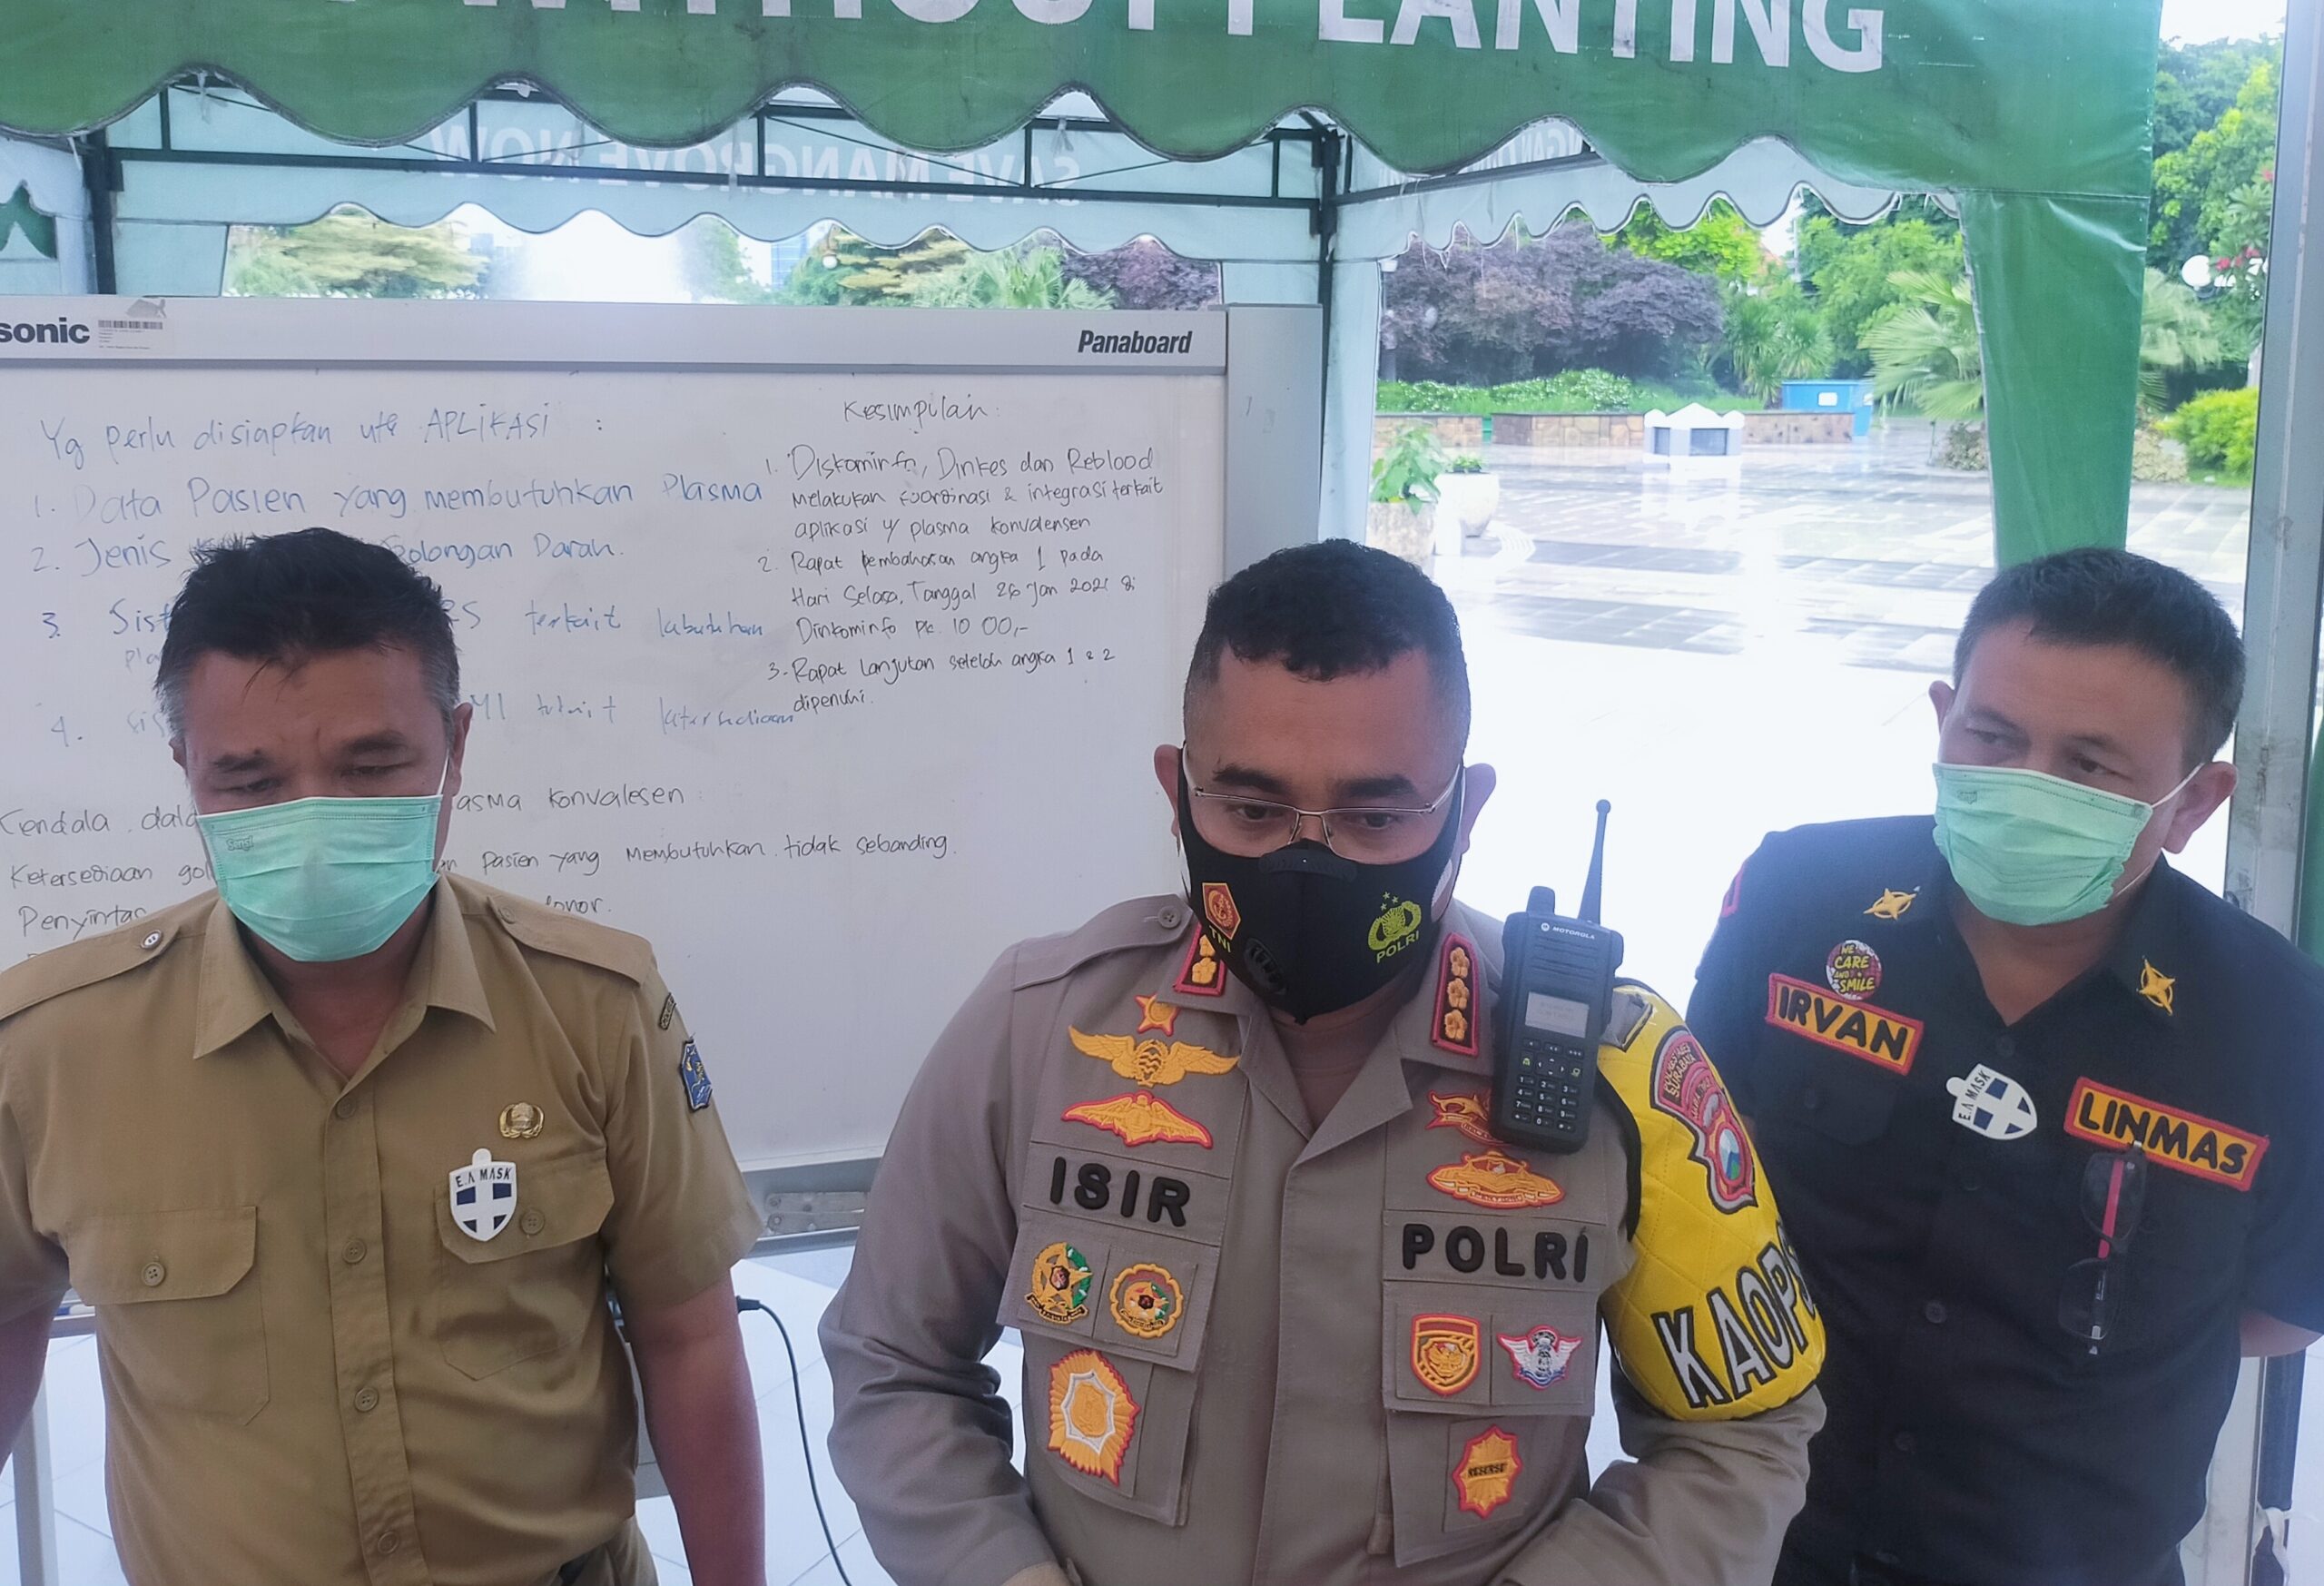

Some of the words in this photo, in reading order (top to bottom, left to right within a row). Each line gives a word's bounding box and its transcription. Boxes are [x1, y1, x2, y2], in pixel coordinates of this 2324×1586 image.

[1078, 330, 1193, 354] Panaboard
[1020, 450, 1054, 473] dan
[1067, 447, 1154, 474] Reblood
[74, 484, 162, 524] Data
[187, 477, 306, 517] Pasien
[1004, 487, 1018, 502] &
[1028, 480, 1107, 507] integrasi
[794, 517, 868, 543] aplikasi
[911, 517, 970, 544] plasma
[32, 547, 60, 572] 2.
[74, 534, 172, 577] Jenis
[791, 551, 843, 576] Rapat
[970, 551, 1019, 575] angka
[792, 586, 831, 607] Hari
[907, 580, 977, 611] Tanggal
[109, 596, 173, 635] Sist
[125, 647, 162, 674] pla
[791, 656, 848, 684] Rapat
[1011, 650, 1057, 675] angka
[1103, 648, 1116, 662] 2
[141, 804, 199, 831] dala
[784, 833, 842, 859] tidak
[178, 863, 215, 887] gol
[1208, 926, 1232, 953] TNI
[1376, 930, 1420, 964] POLRI
[1552, 926, 1595, 941] MOTOROLA
[1833, 970, 1850, 980] AND
[1834, 954, 1870, 970] CARE
[1839, 977, 1876, 993] SMILE
[1777, 985, 1908, 1061] IRVAN
[1541, 1080, 1547, 1089] 2
[2078, 1091, 2249, 1175] LINMAS
[480, 1167, 511, 1180] MASK
[1049, 1156, 1191, 1227] ISIR
[1402, 1223, 1590, 1284] POLRI
